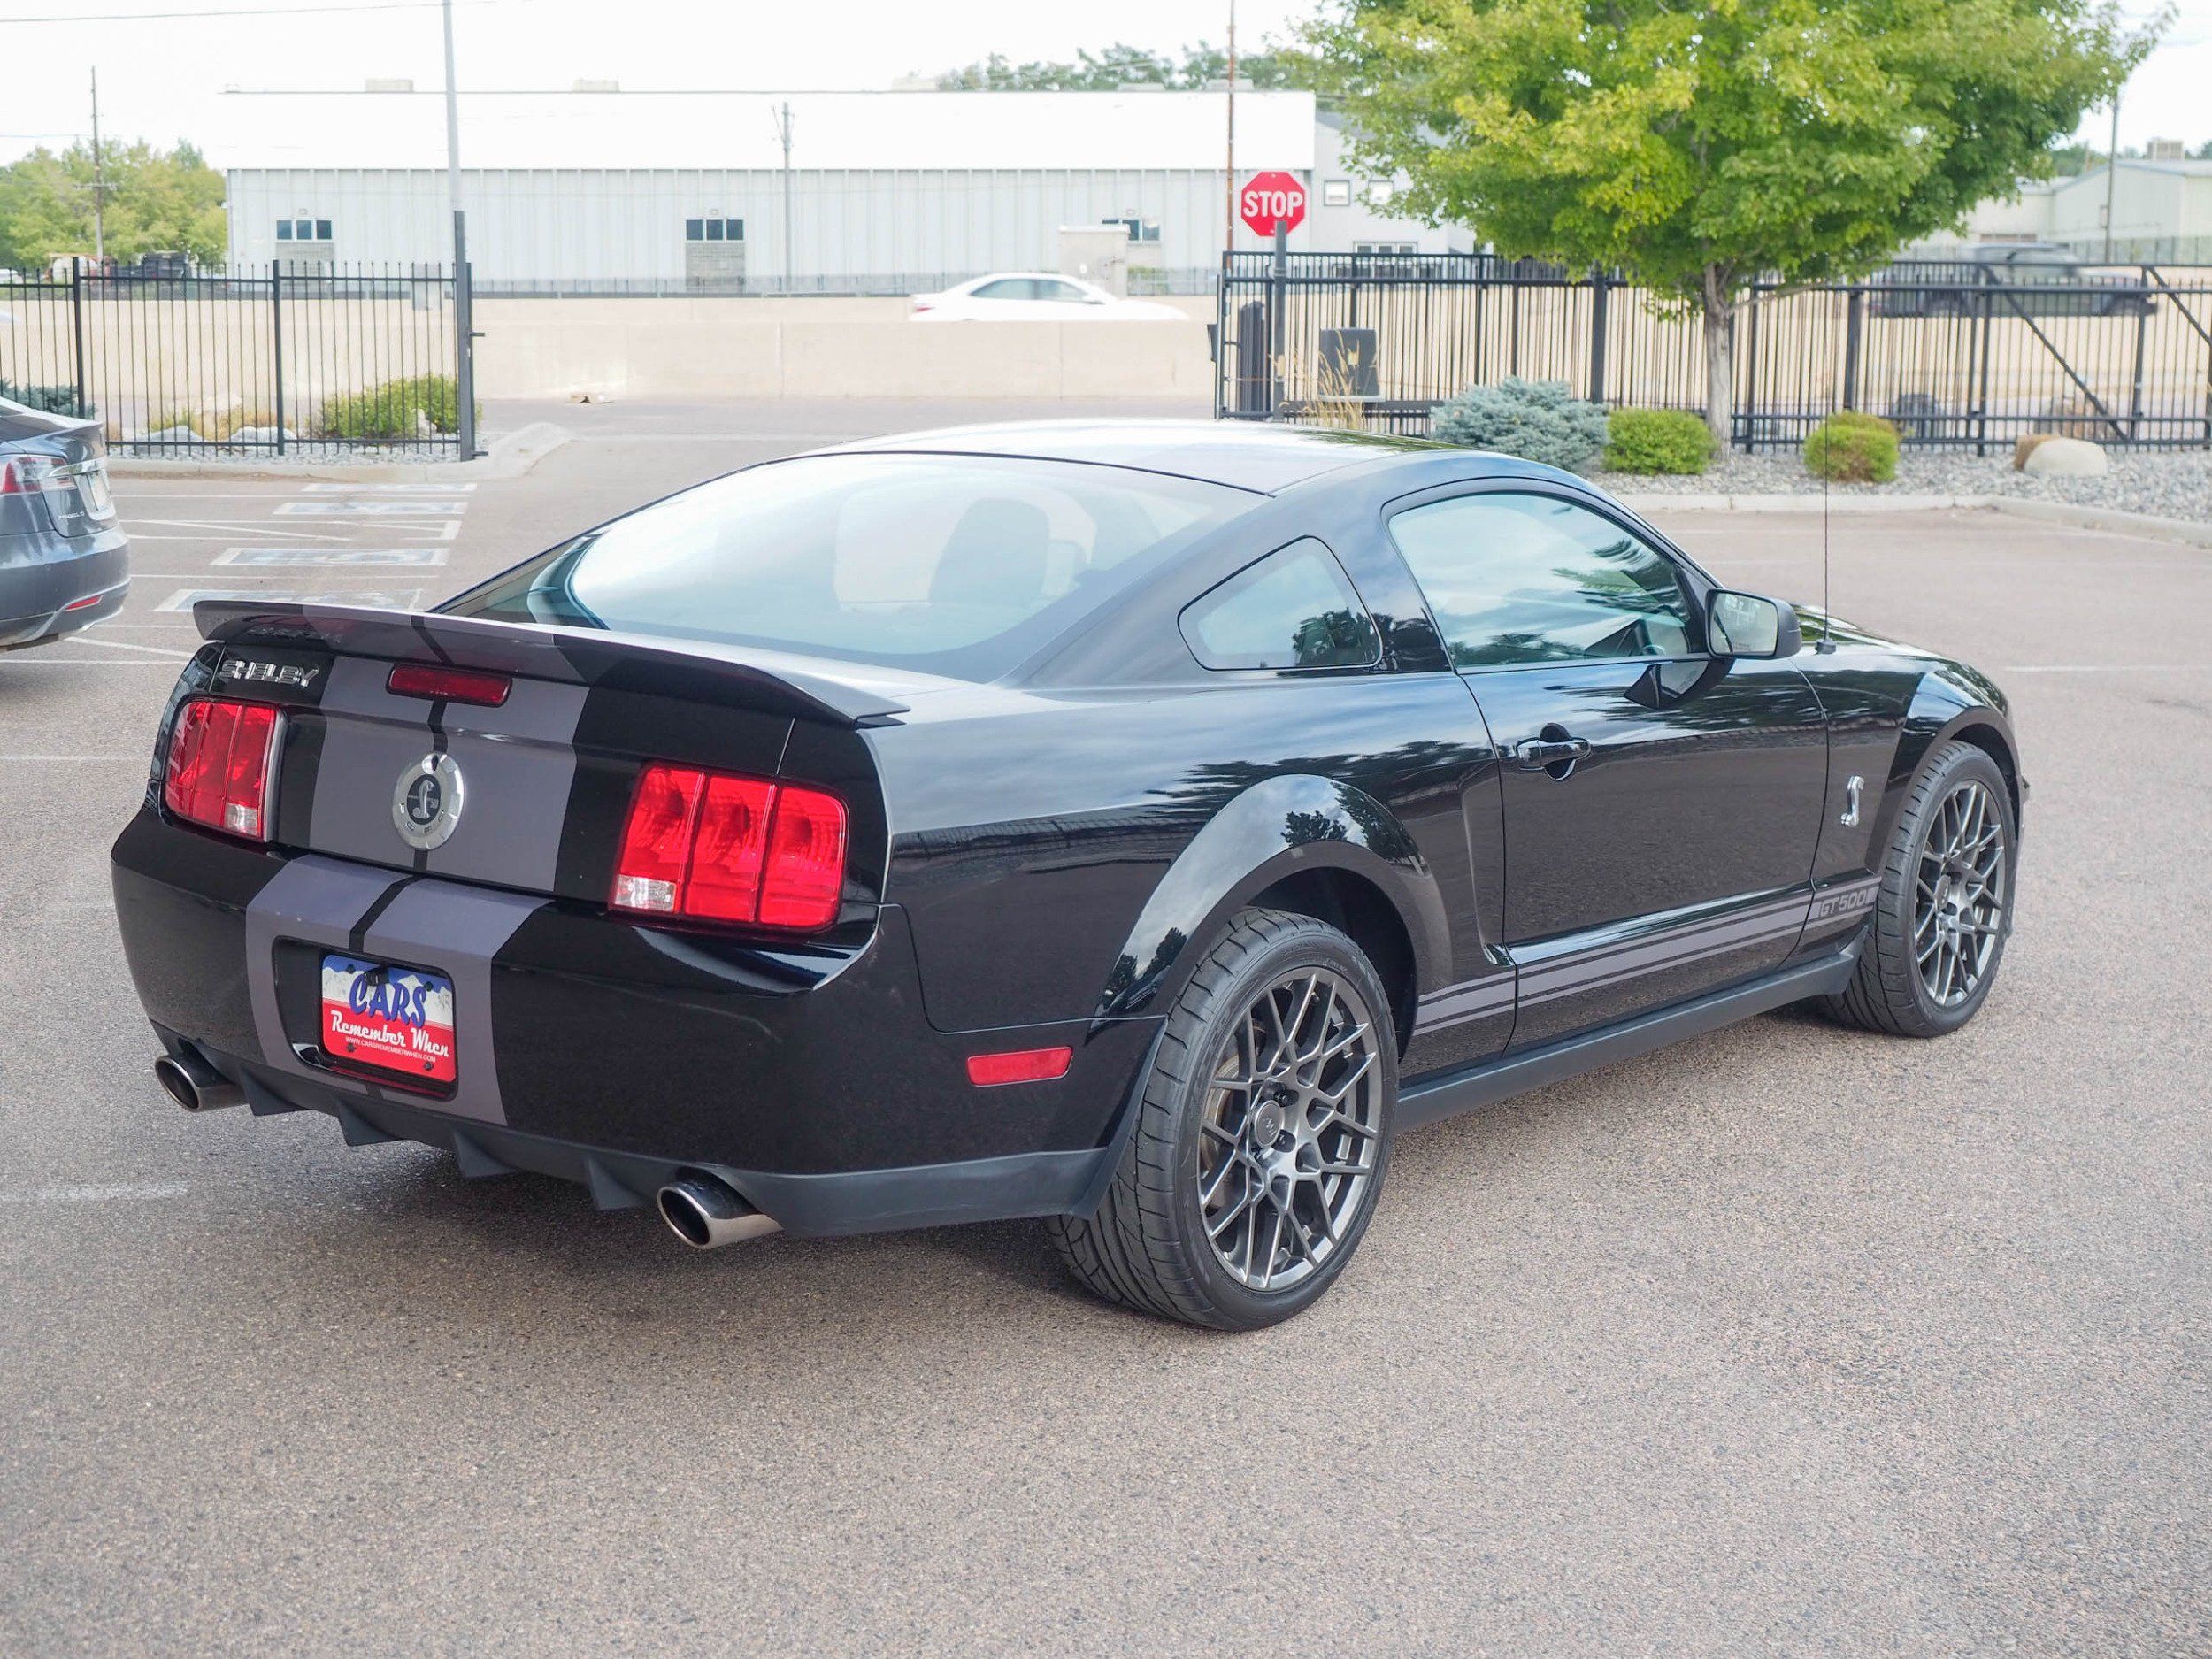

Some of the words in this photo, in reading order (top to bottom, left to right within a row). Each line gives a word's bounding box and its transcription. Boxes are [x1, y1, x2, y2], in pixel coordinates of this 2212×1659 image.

[1243, 190, 1303, 219] STOP
[220, 660, 319, 687] SHELBY
[350, 974, 427, 1027] CARS
[331, 1010, 406, 1047] Remember
[411, 1028, 449, 1057] When
